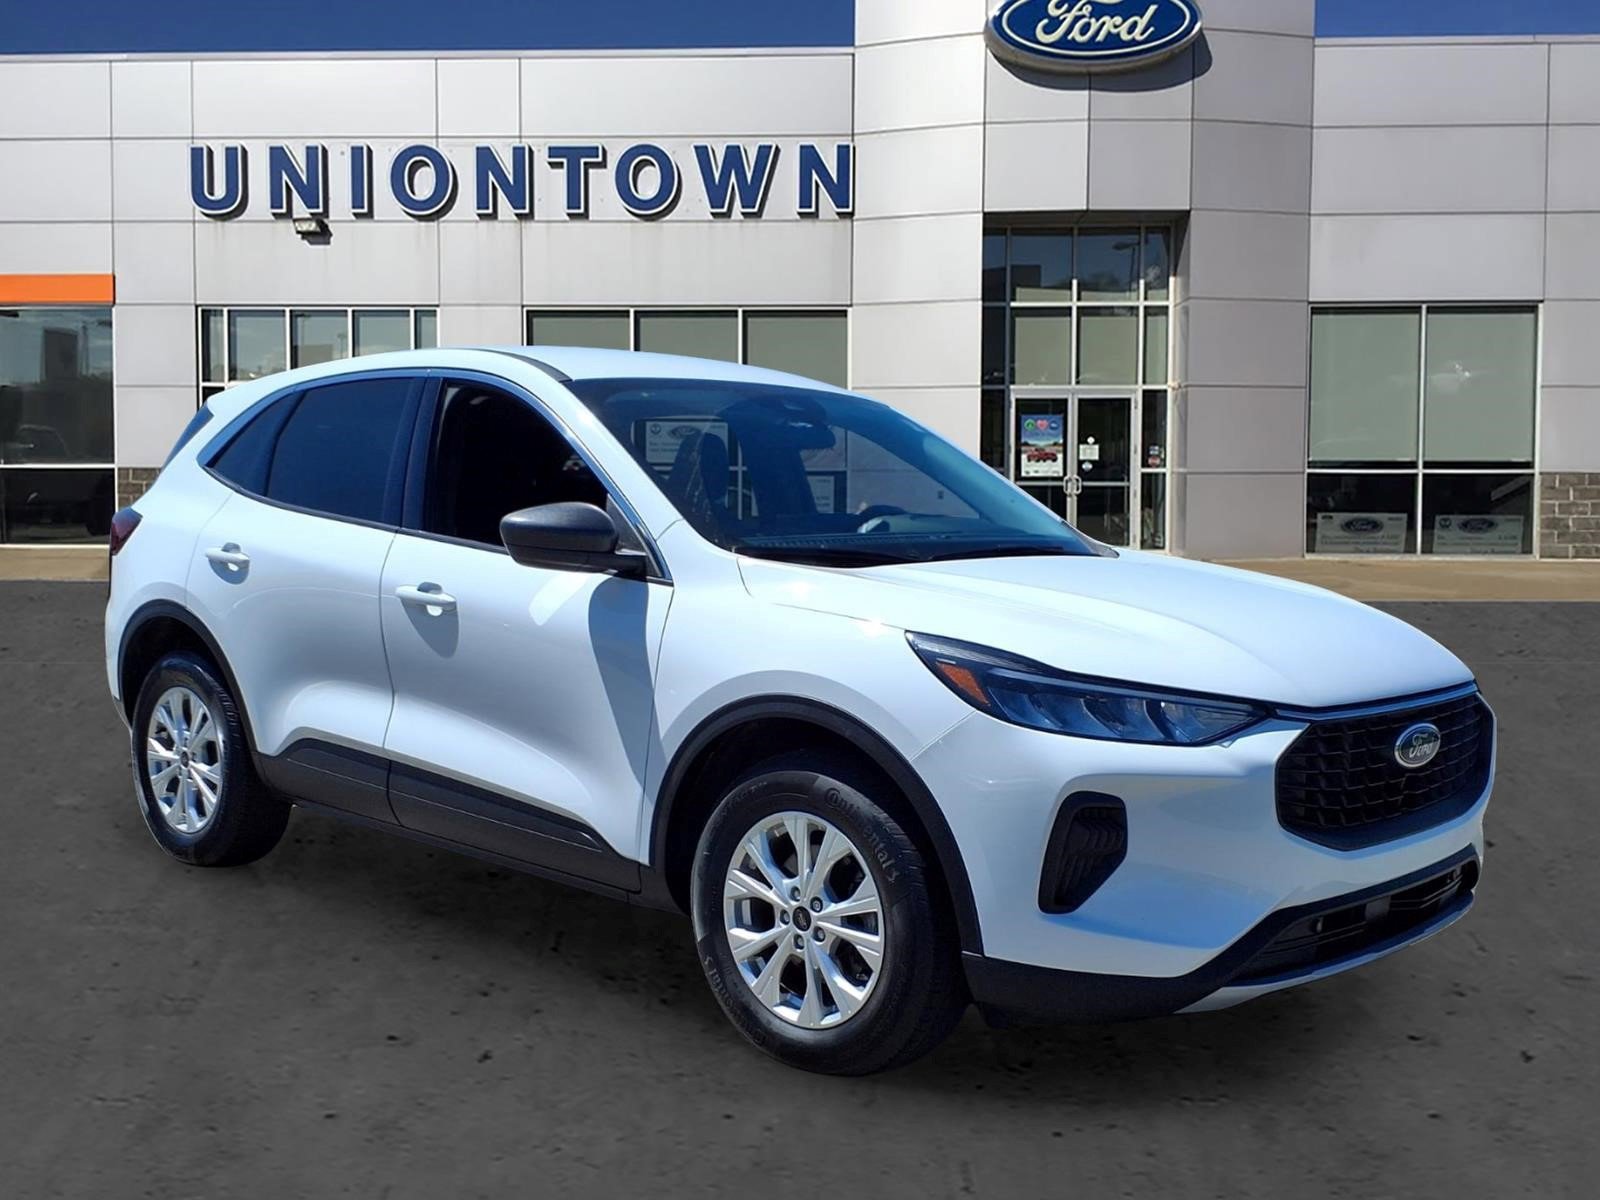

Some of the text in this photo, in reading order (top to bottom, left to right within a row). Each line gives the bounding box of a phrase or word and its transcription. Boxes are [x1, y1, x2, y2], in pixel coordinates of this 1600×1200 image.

[1035, 0, 1156, 44] Ford
[190, 143, 854, 217] UNIONTOWN
[1408, 733, 1435, 758] Ford
